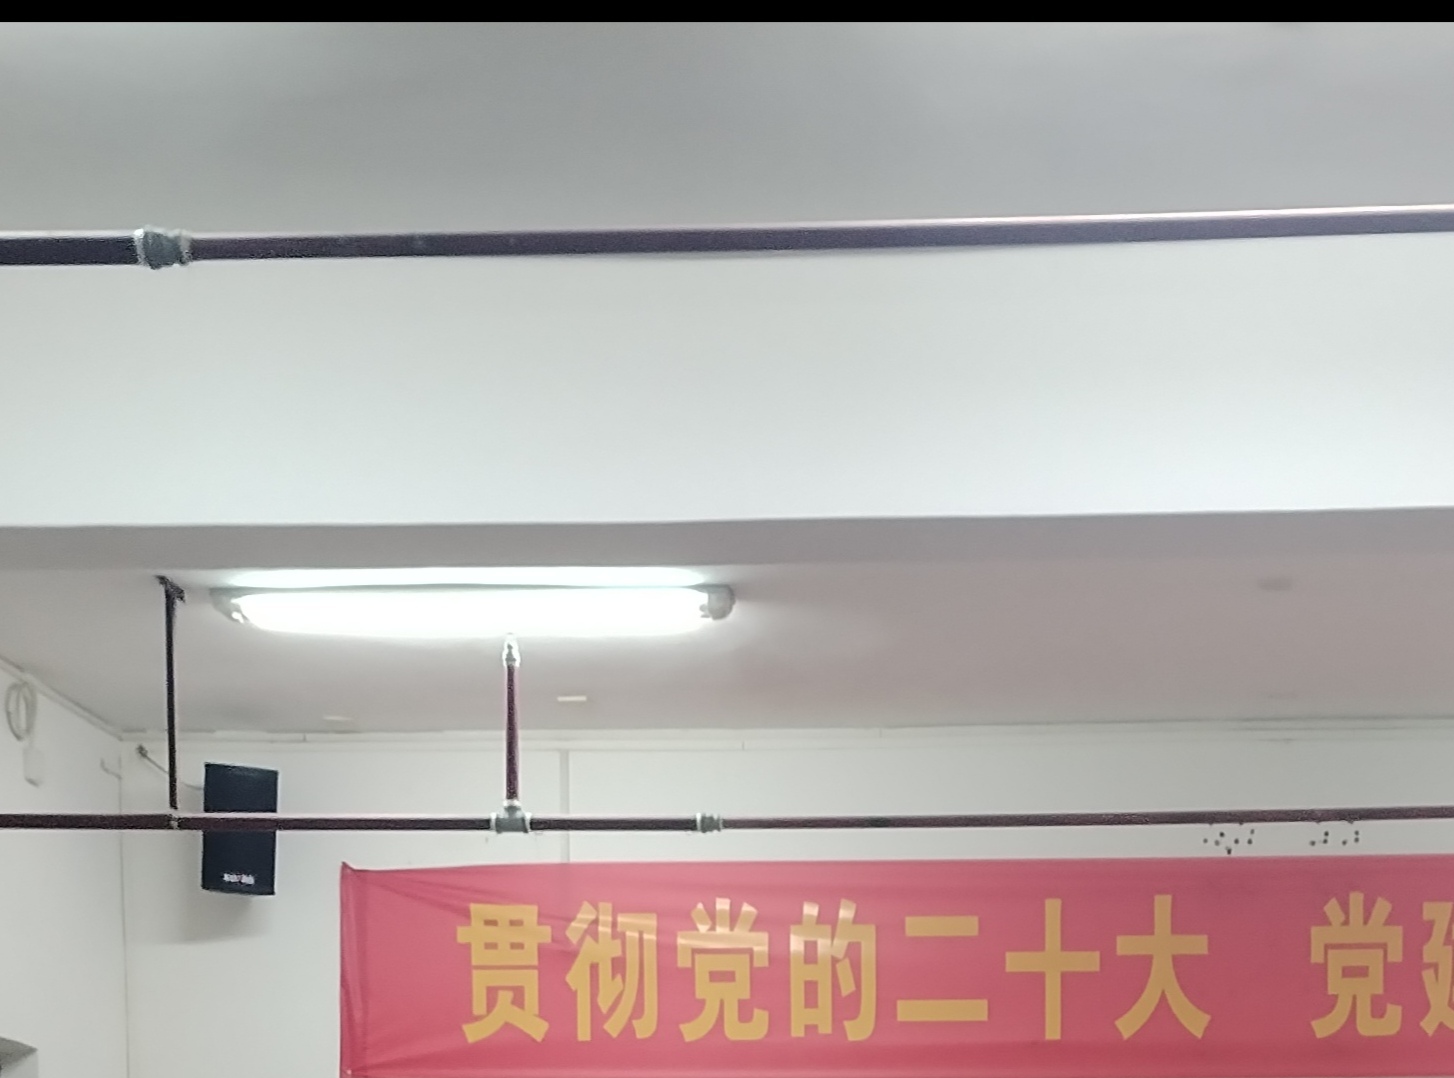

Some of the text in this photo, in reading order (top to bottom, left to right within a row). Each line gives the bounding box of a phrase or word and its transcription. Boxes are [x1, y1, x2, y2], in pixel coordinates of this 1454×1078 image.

[457, 895, 1212, 1043] 贯彻党的二十大
